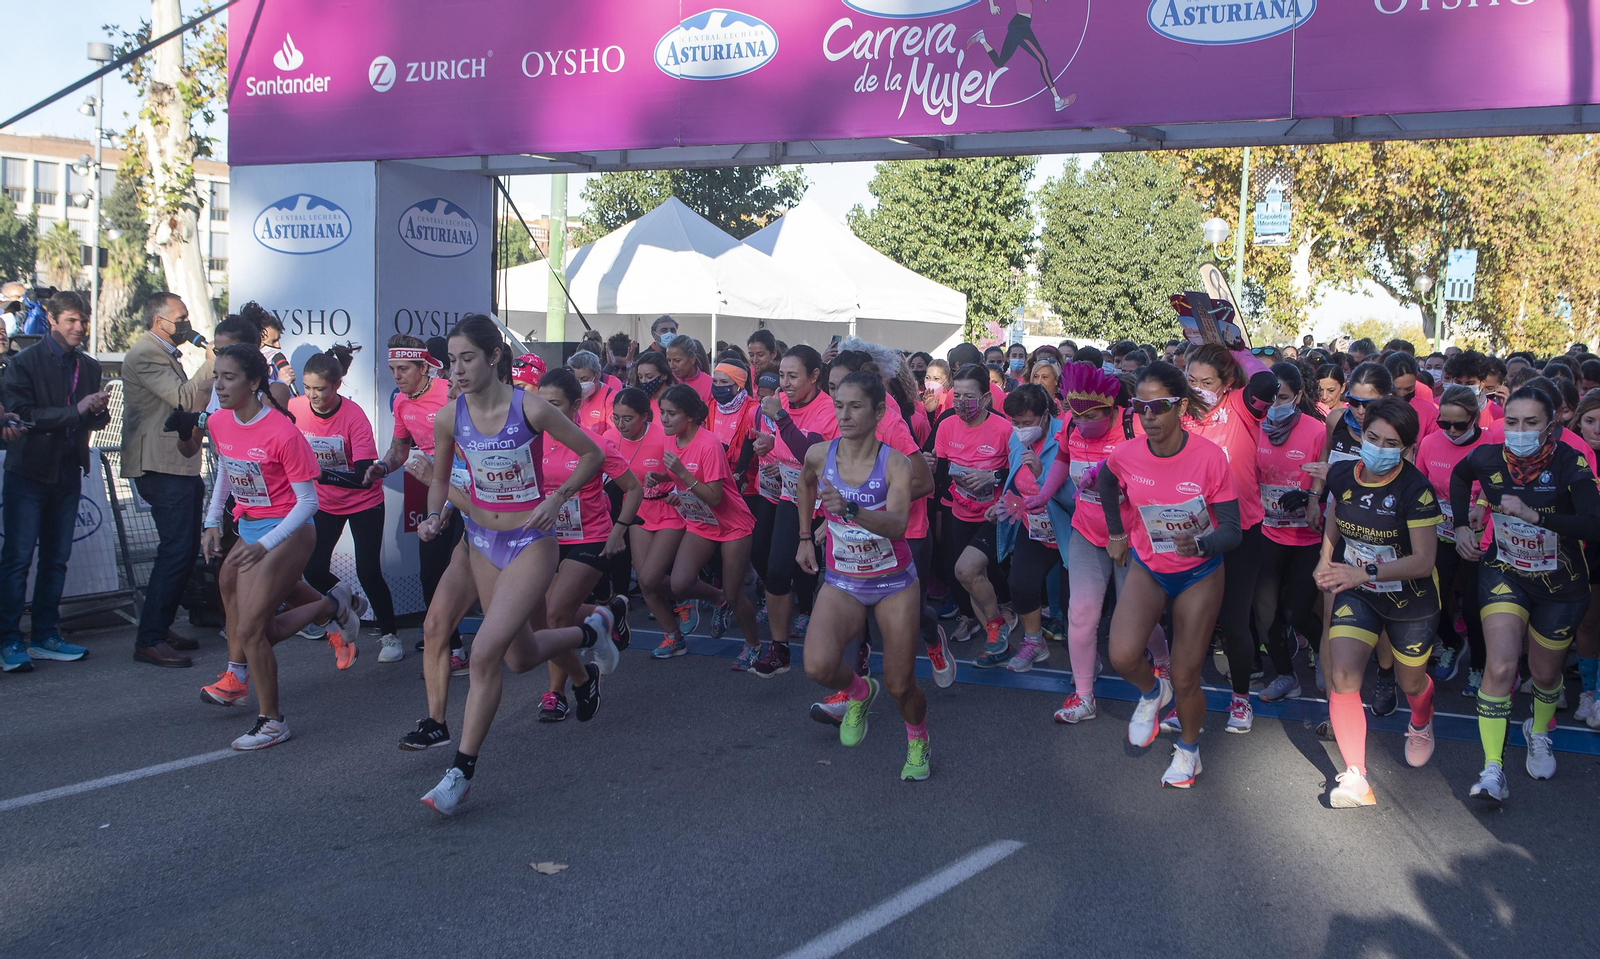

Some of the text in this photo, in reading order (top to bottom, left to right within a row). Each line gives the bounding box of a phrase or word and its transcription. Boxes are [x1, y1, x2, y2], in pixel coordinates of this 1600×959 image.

[1160, 0, 1303, 28] ASTURIANA
[681, 30, 764, 43] CENTRAL LECHERA
[822, 17, 957, 62] Carrera
[521, 45, 625, 78] OYSHO
[664, 40, 768, 66] ASTURIANA
[246, 73, 331, 96] Santander
[854, 49, 1009, 126] de la Mujer
[261, 217, 344, 239] ASTURIANA
[404, 216, 473, 245] ASTURIANA
[417, 216, 471, 228] CENTRAL LECHERA
[271, 308, 351, 336] YSHO
[394, 308, 475, 337] OYSH
[486, 470, 515, 482] 016
[838, 488, 876, 503] eiman
[1165, 521, 1192, 531] 016
[1340, 528, 1384, 545] MIRAFLORES
[1357, 524, 1398, 538] PIRÁMIDE
[1511, 536, 1537, 550] 016
